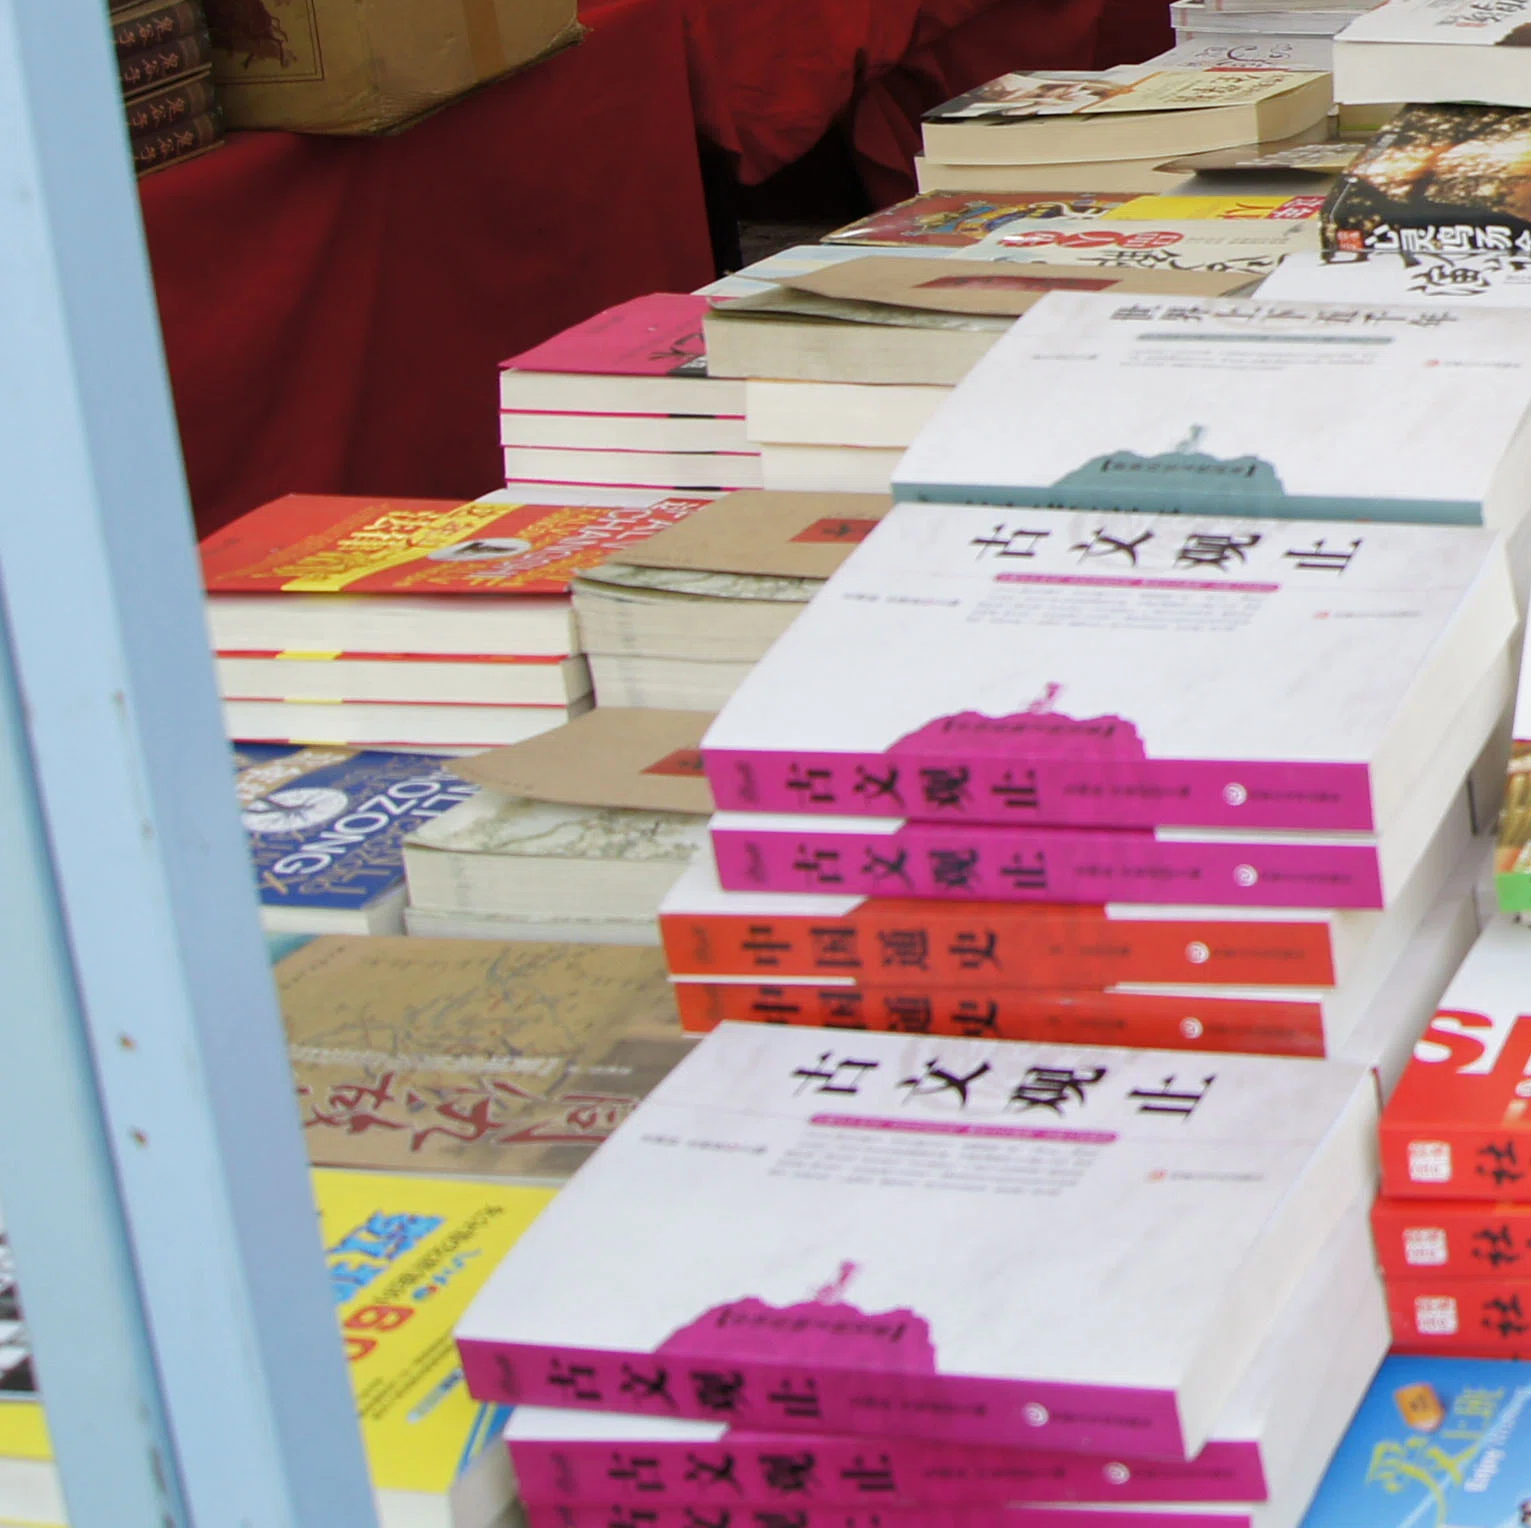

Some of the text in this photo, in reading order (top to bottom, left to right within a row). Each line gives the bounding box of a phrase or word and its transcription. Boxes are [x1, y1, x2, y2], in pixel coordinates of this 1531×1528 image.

[969, 523, 1366, 577] 古文观止
[786, 764, 1043, 813] 古文观止
[793, 844, 1051, 895] 古文观止
[739, 923, 1002, 974] 中国通史
[750, 986, 1000, 1038] 中国通史
[789, 1047, 1218, 1119] 古文观止
[546, 1356, 825, 1424] 古文观止
[605, 1450, 899, 1501] 古文观止
